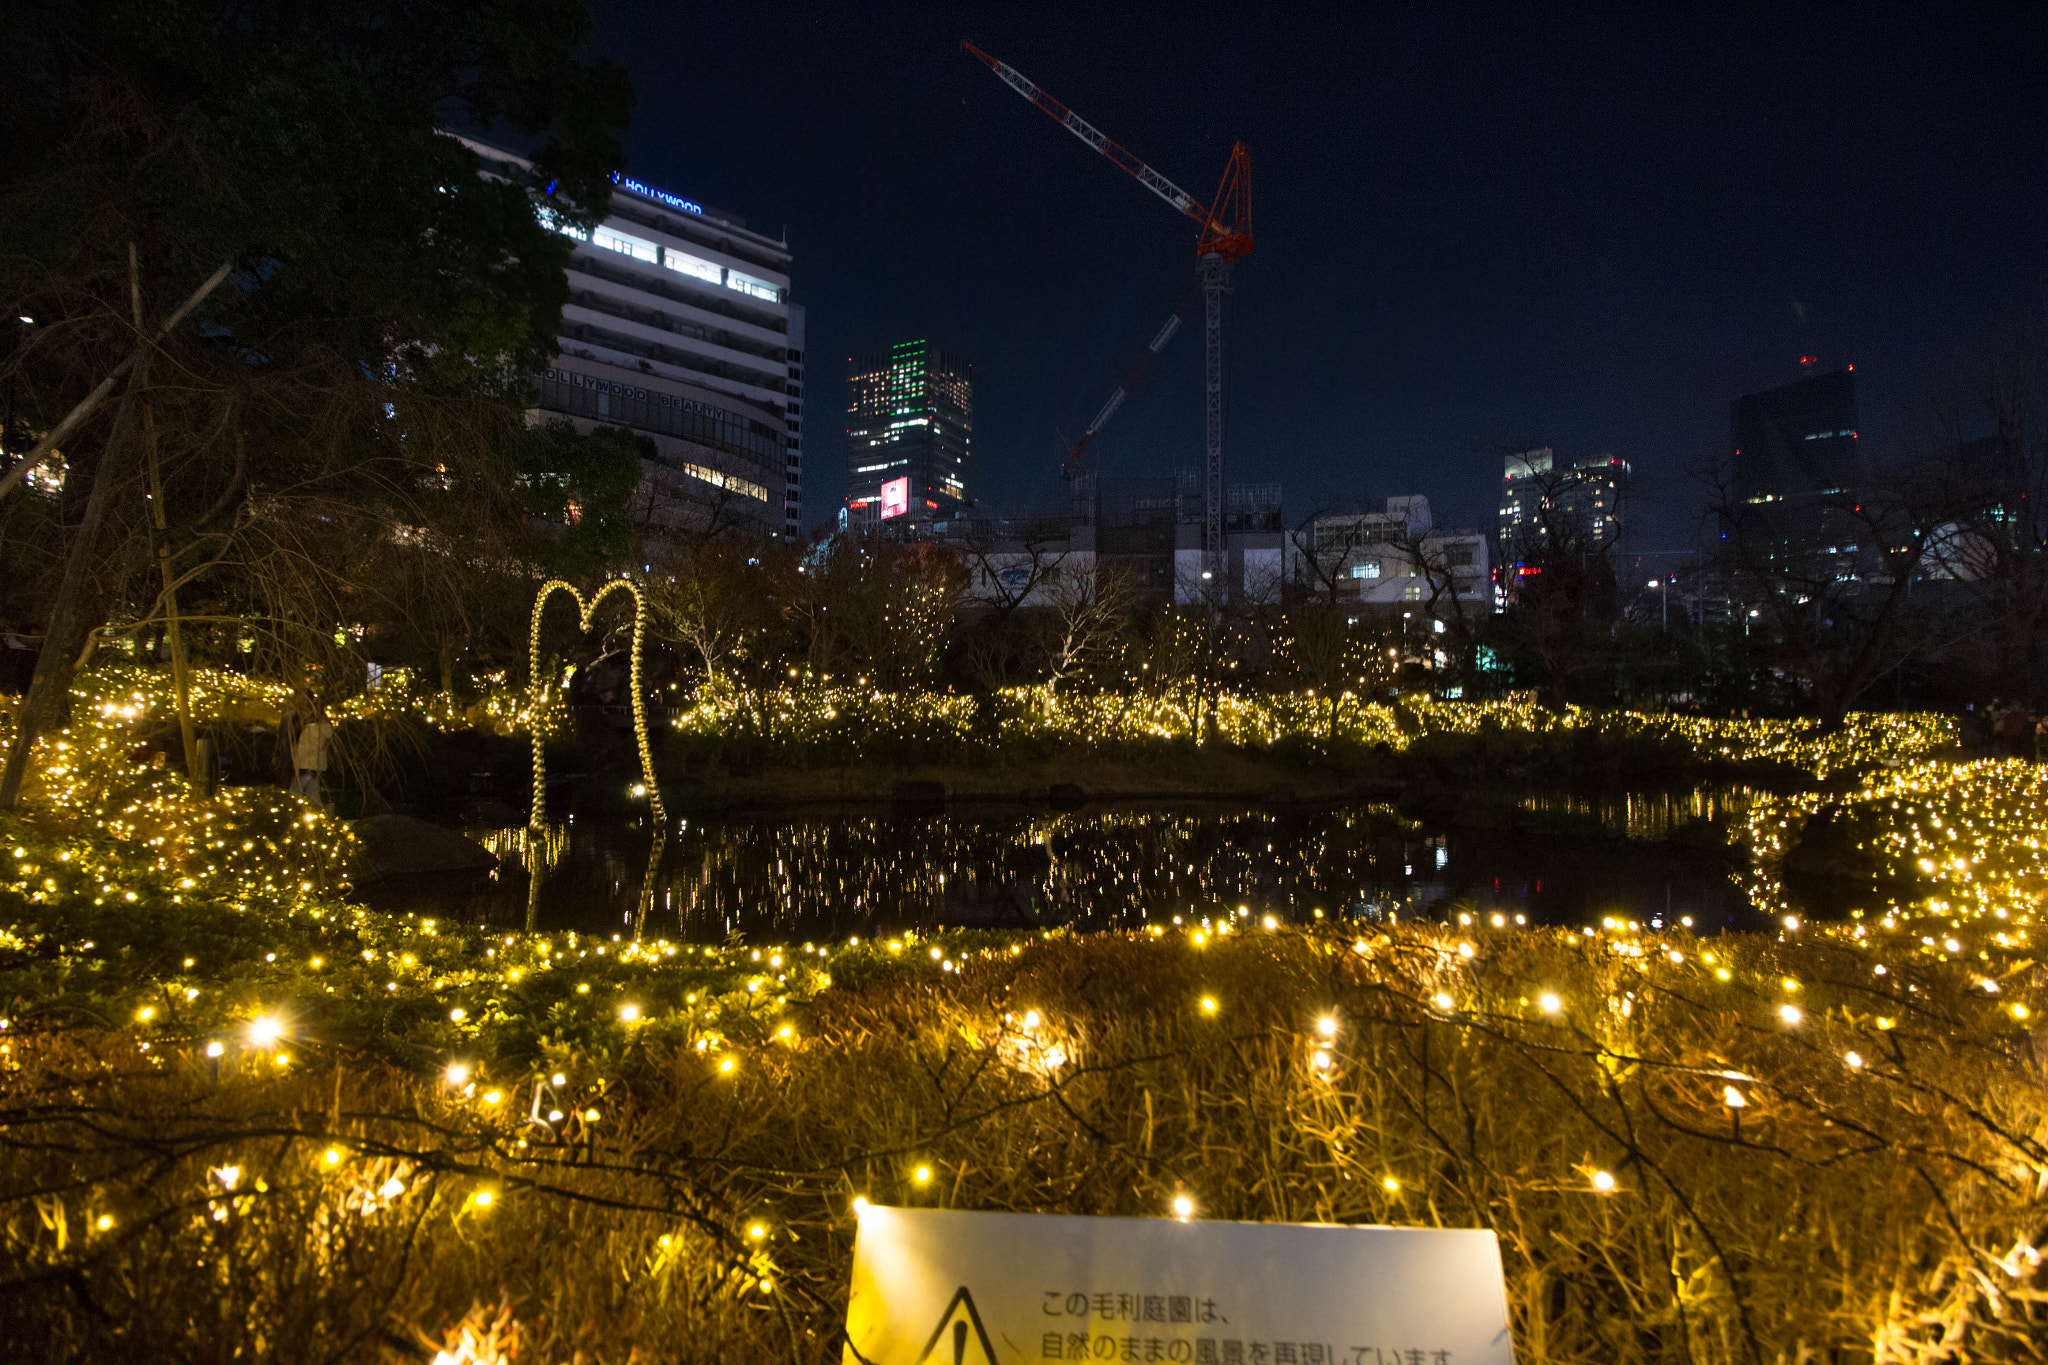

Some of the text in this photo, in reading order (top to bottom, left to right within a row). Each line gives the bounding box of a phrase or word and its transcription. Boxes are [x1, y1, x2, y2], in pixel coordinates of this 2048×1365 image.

[533, 369, 723, 419] OLLYWOOD BEAUTY
[1042, 1291, 1229, 1324] この毛利庭園は、
